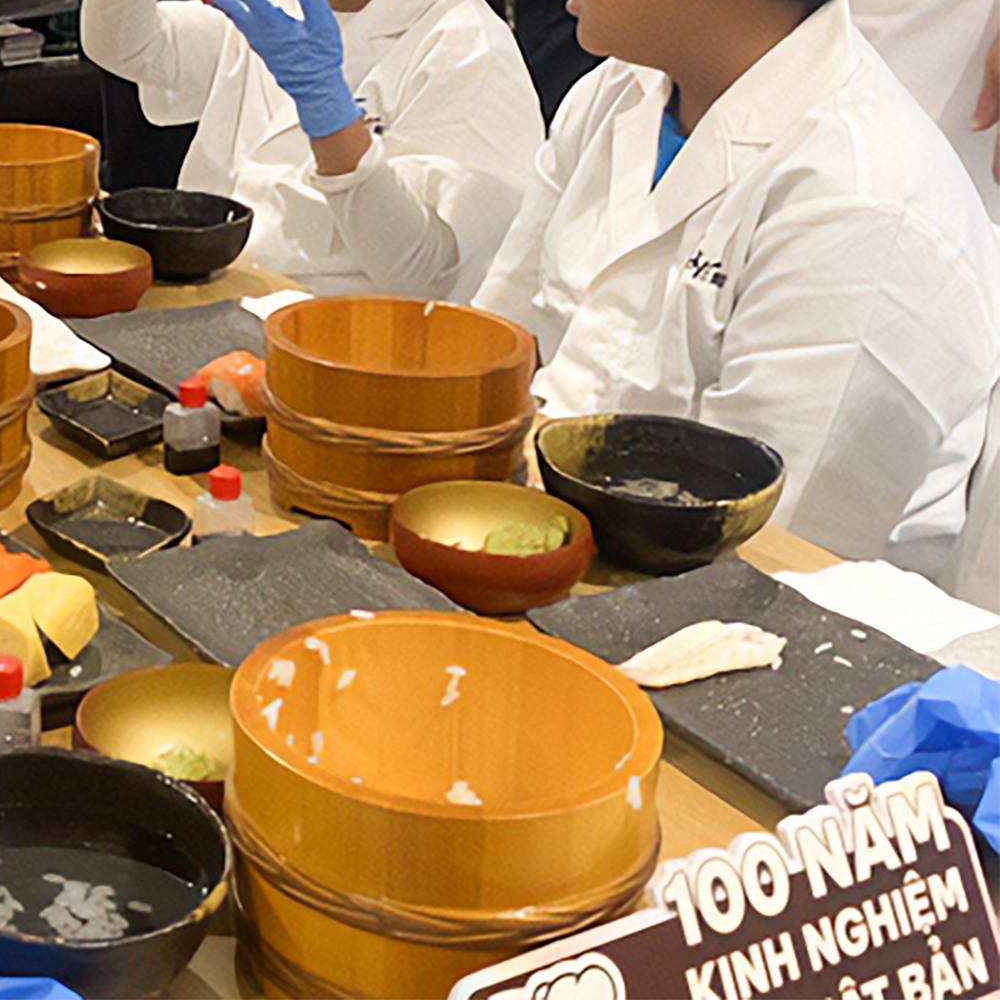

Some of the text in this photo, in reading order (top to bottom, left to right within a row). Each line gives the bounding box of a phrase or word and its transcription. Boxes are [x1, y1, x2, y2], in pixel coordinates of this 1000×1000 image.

[663, 782, 951, 946] 100 NĂM
[685, 867, 970, 1000] KINH NGHIỆM
[897, 934, 990, 1000] BẢN
